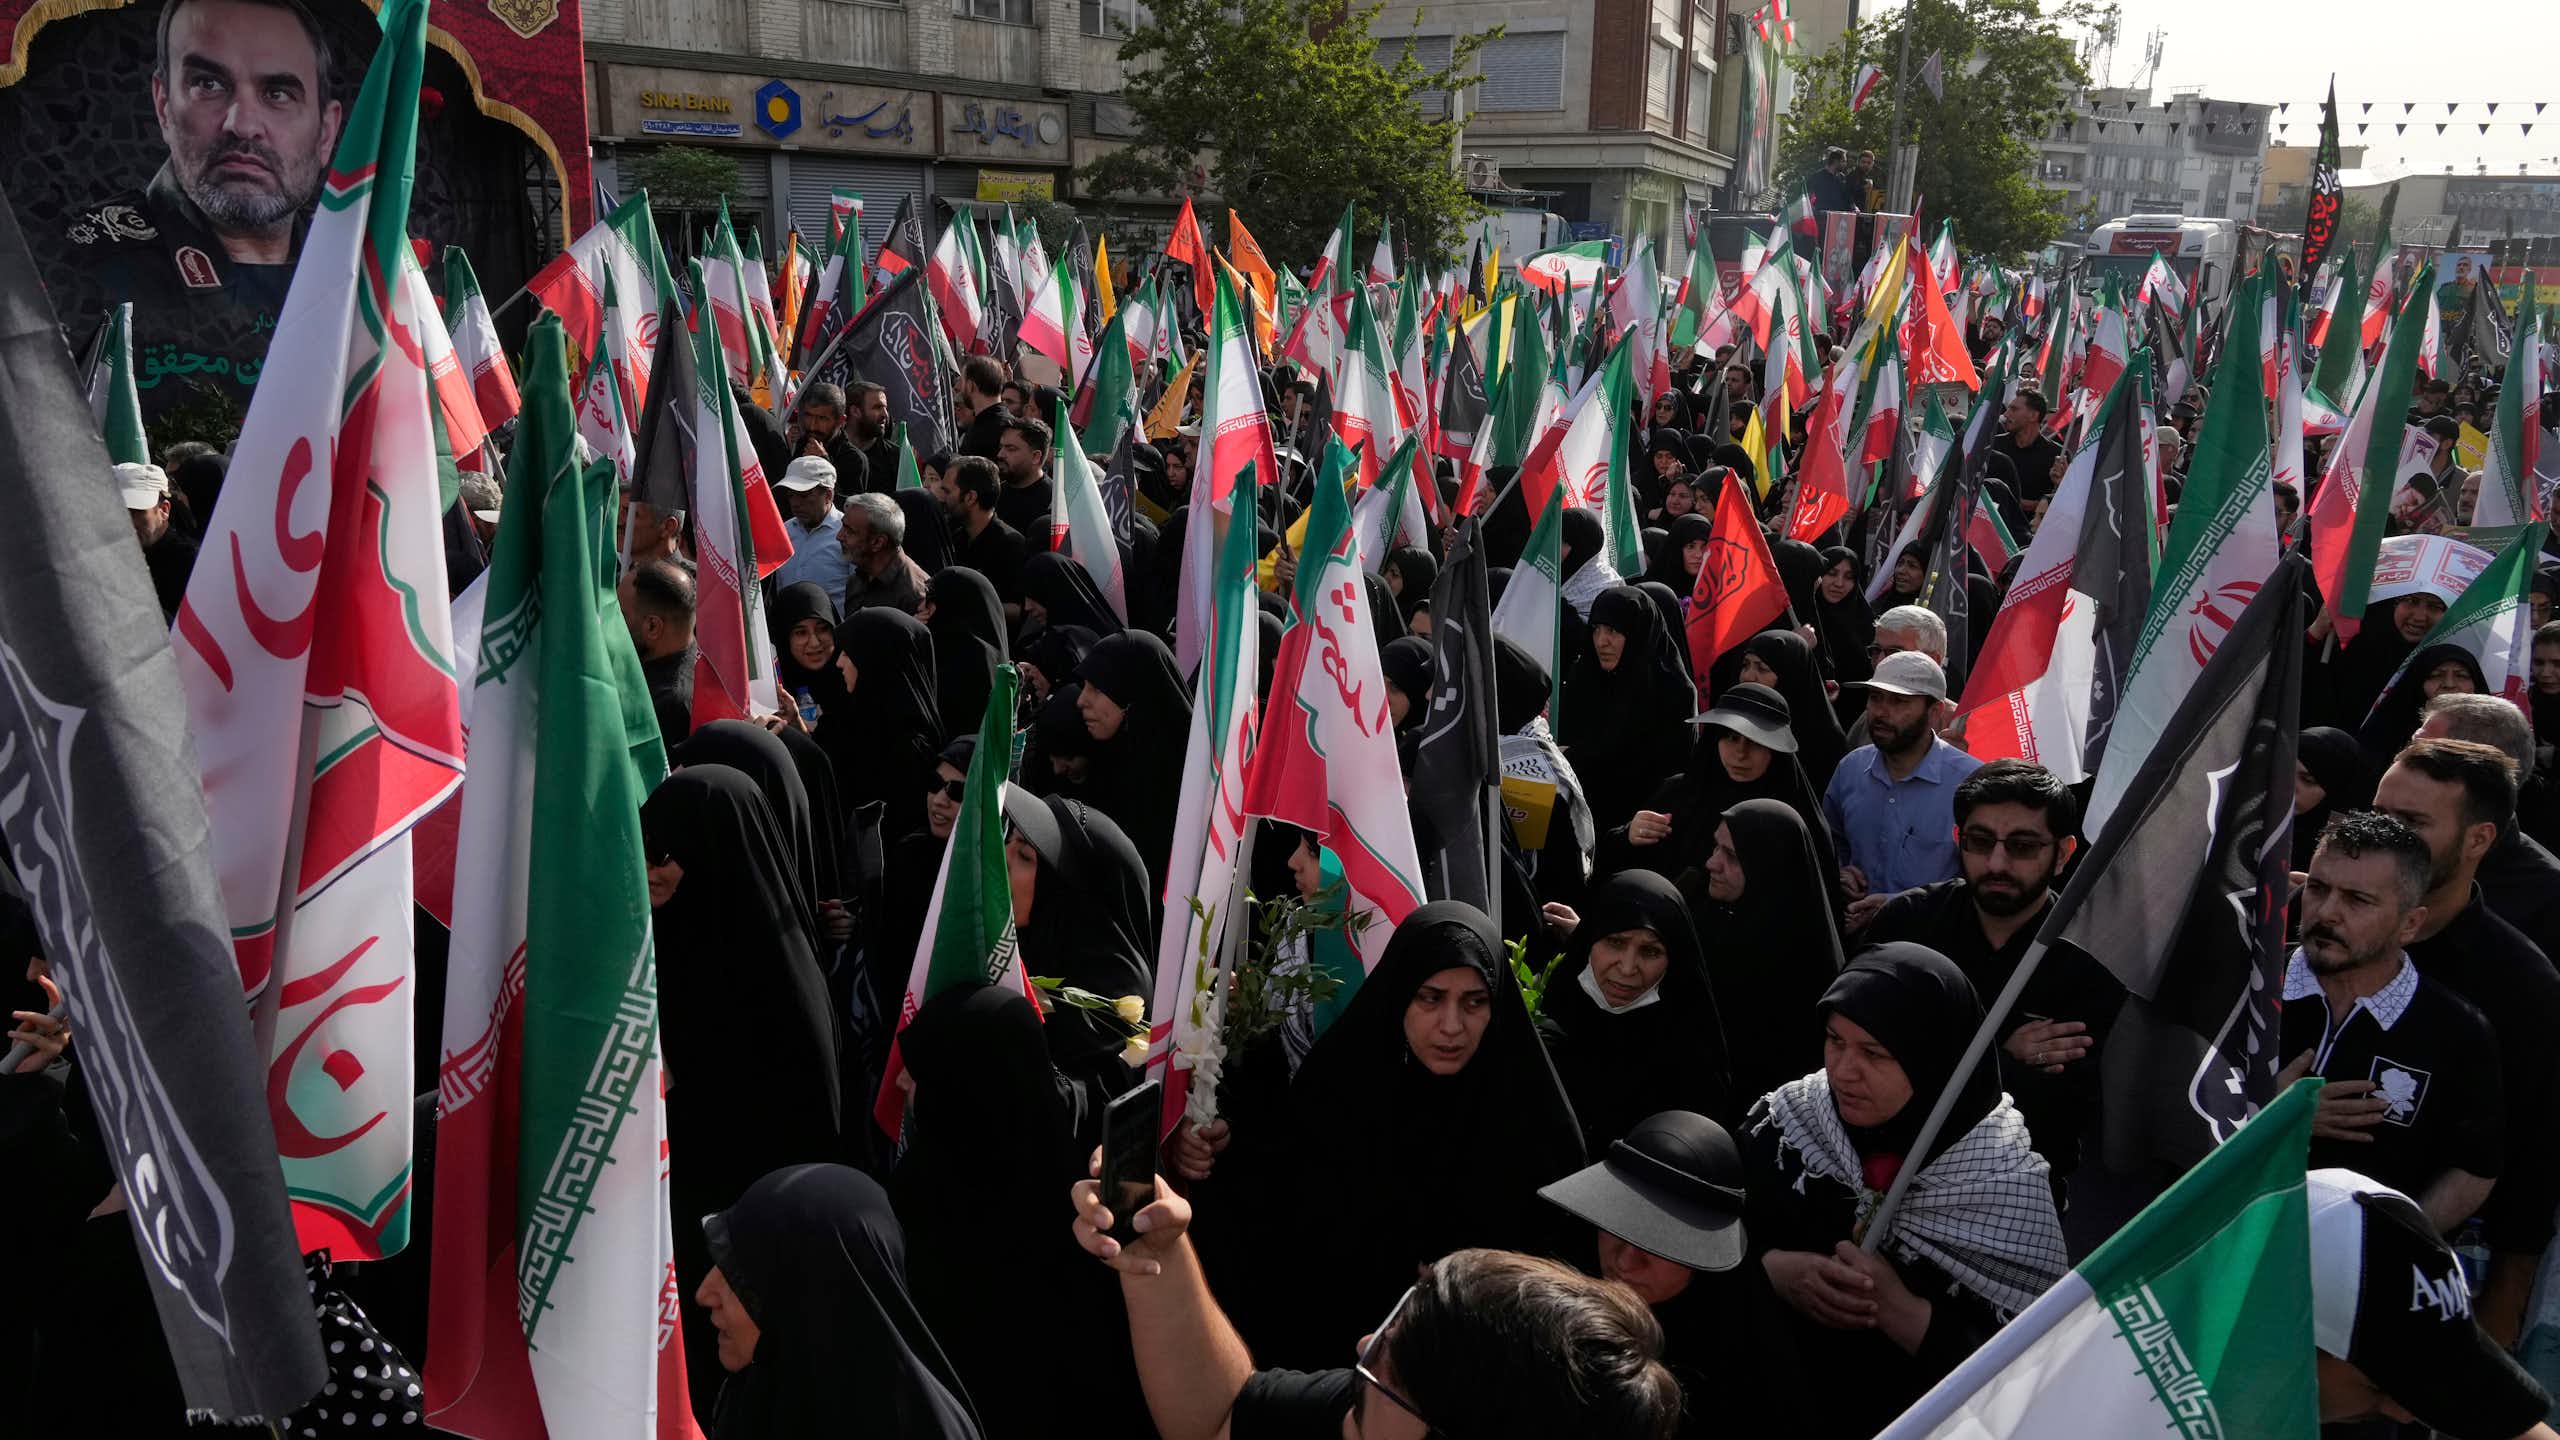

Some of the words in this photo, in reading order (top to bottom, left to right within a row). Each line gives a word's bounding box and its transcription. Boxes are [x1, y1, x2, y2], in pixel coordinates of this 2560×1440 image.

[640, 90, 682, 109] SINA
[686, 93, 733, 112] BANK
[818, 91, 888, 138] سینا
[864, 92, 914, 144] بانک
[136, 343, 230, 389] محقق
